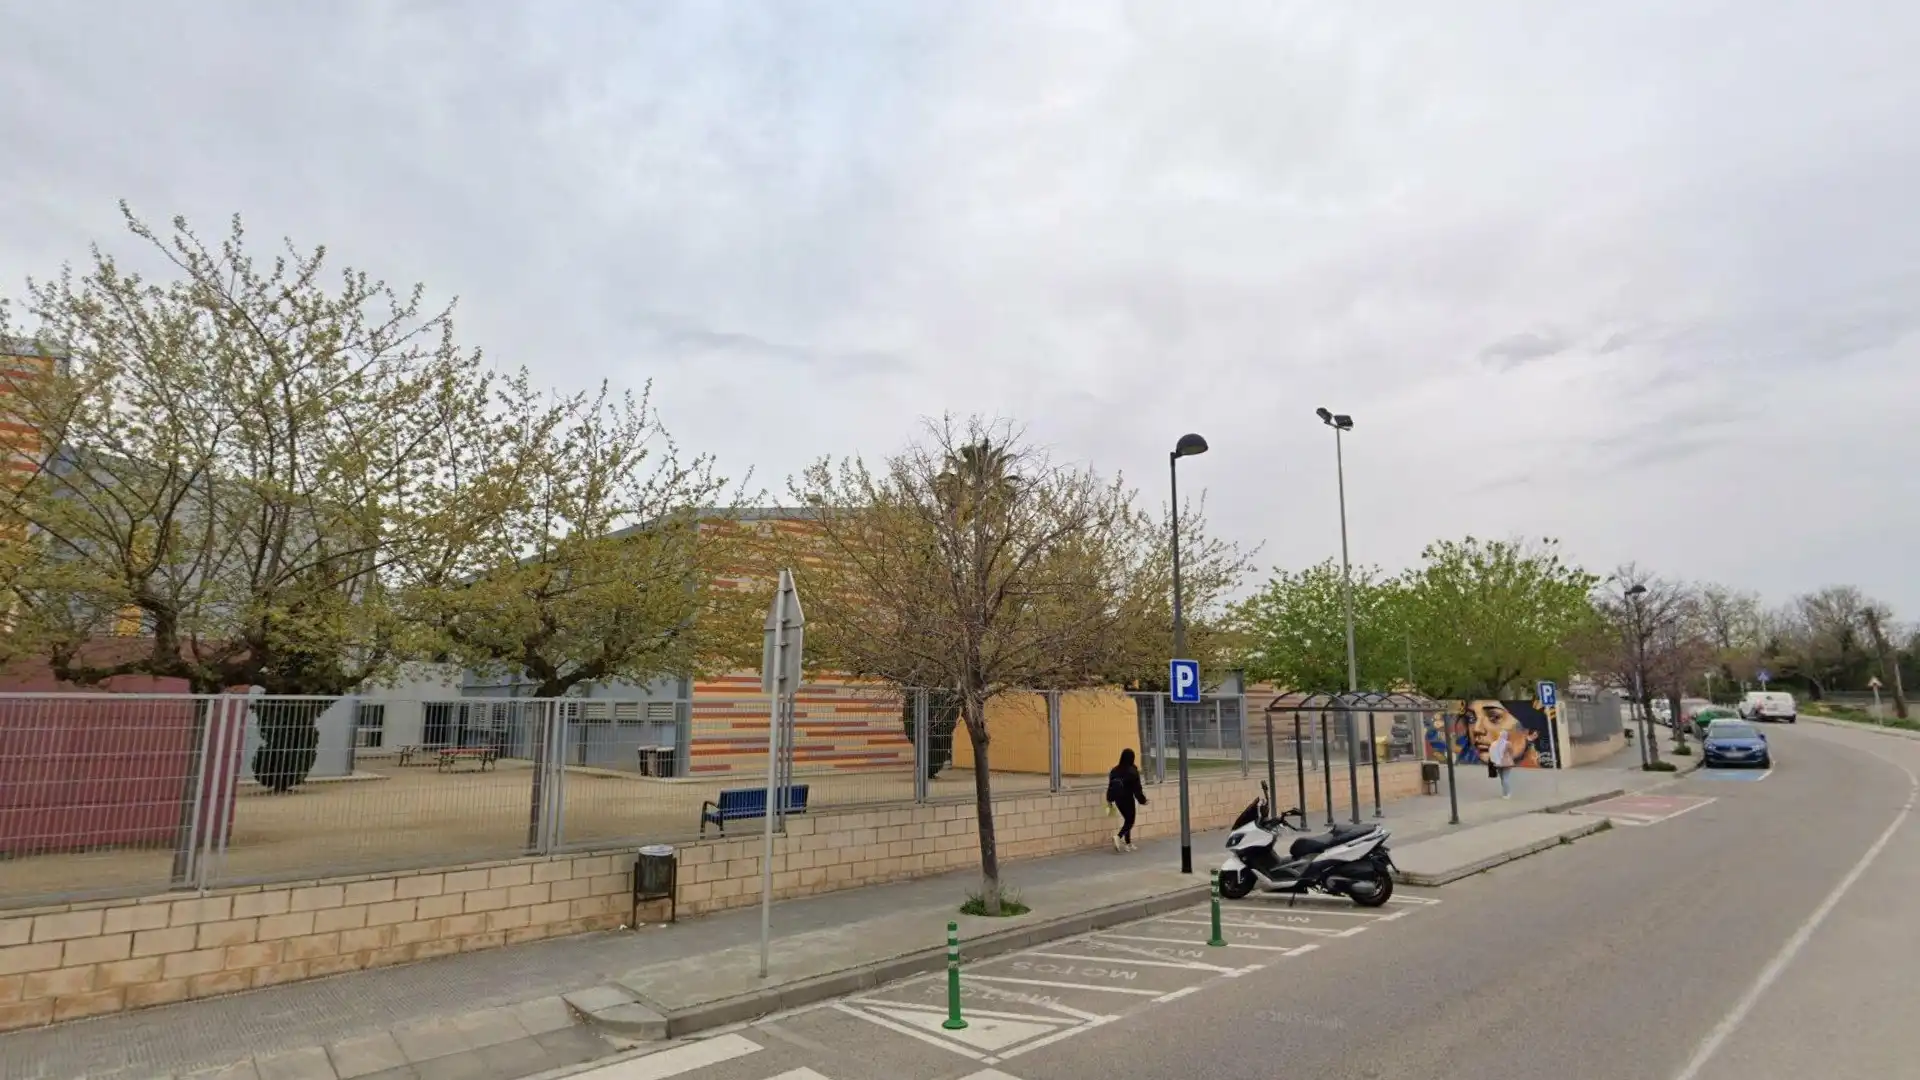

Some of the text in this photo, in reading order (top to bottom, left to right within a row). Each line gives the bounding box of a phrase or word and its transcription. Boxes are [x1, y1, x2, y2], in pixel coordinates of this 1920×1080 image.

[1176, 665, 1194, 698] P
[1542, 685, 1553, 704] P
[1009, 961, 1138, 981] MOTOS
